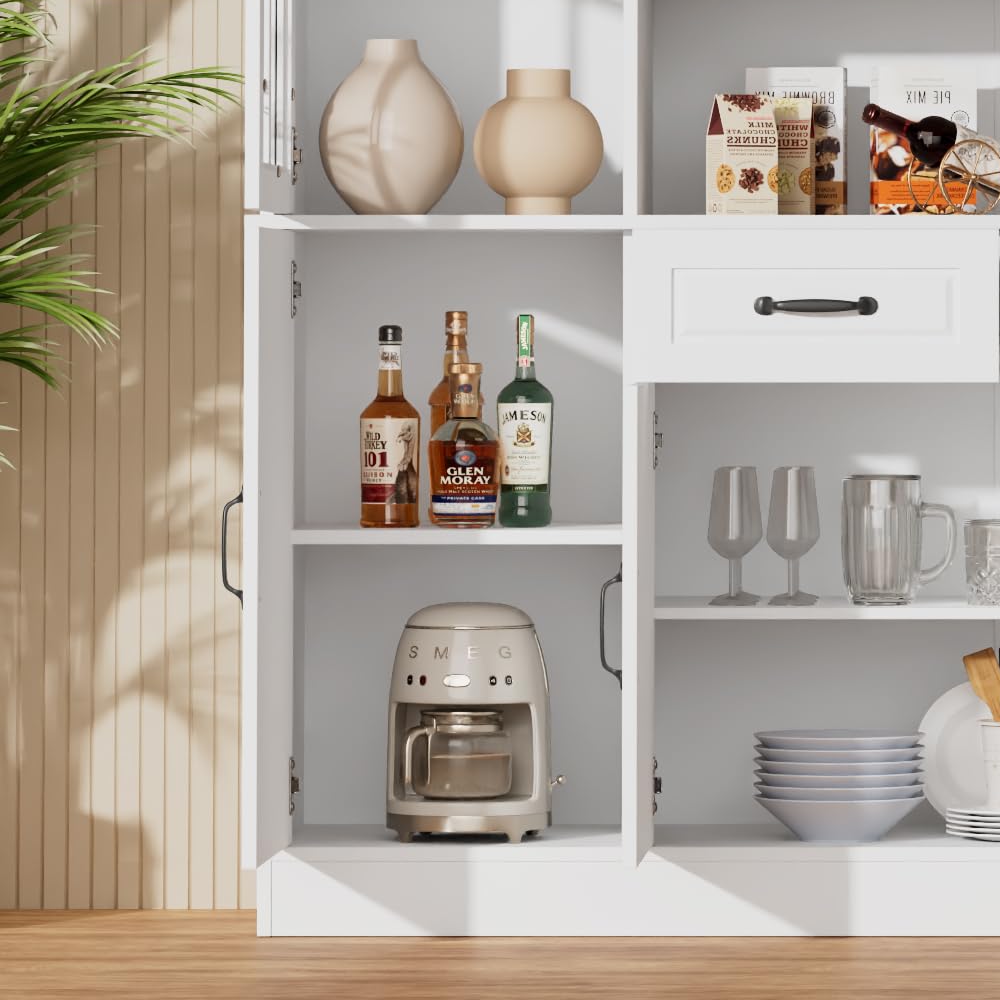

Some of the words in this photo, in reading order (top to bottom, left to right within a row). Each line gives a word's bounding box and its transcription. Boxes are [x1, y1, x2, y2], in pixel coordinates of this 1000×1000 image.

[502, 410, 546, 425] JAMESON
[365, 431, 381, 440] WILD
[364, 451, 389, 468] 101
[446, 466, 484, 476] GLEN
[440, 475, 491, 485] MORAY
[408, 645, 512, 660] SMEG
